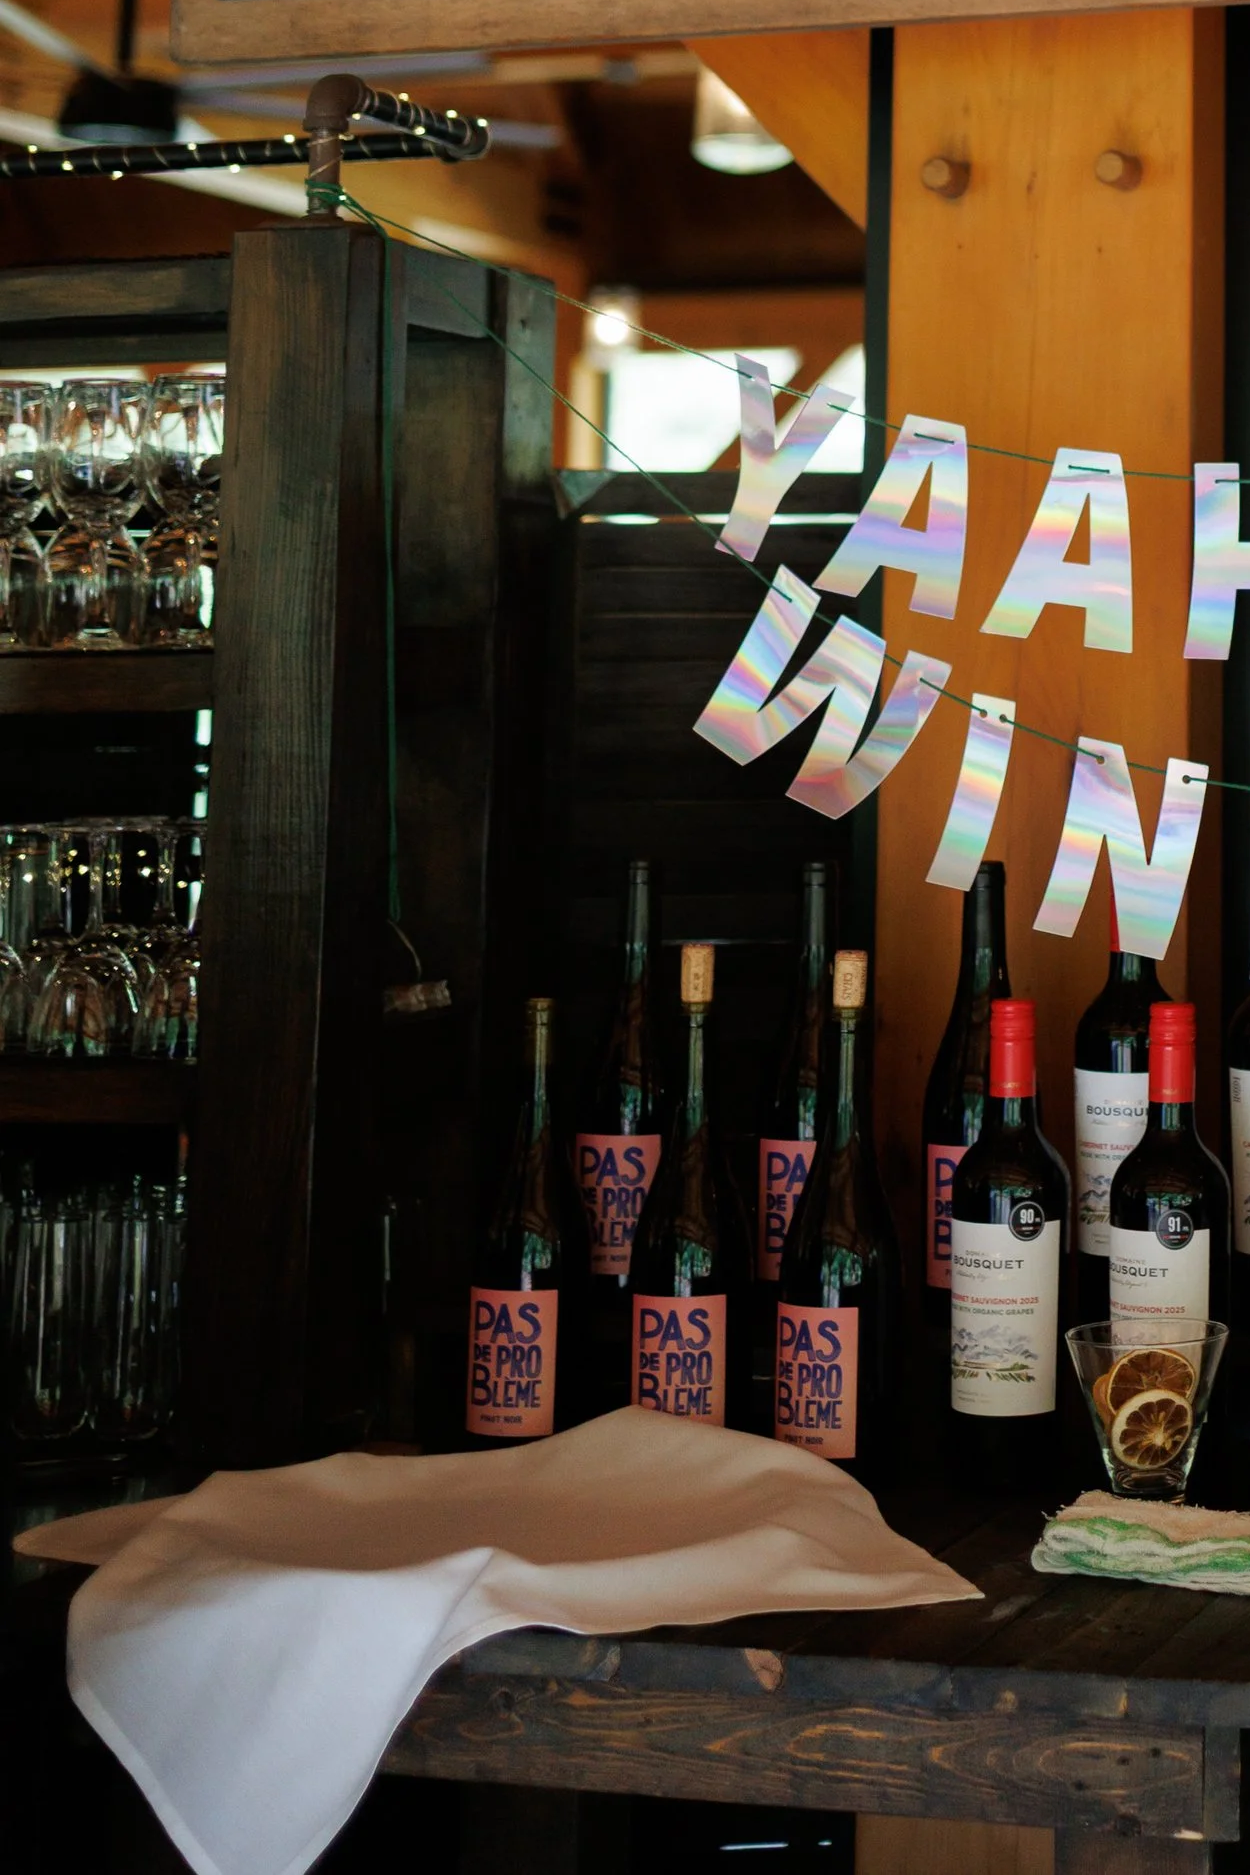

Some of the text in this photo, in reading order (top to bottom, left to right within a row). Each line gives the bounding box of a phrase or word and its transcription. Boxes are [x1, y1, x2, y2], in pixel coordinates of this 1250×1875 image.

[1086, 1105, 1149, 1117] BOUSQU
[580, 1146, 645, 1186] PAS
[767, 1152, 808, 1192] PA
[602, 1187, 646, 1219] PRO
[766, 1192, 787, 1211] DE
[1020, 1209, 1034, 1224] 90
[1168, 1216, 1180, 1232] 91
[953, 1255, 1024, 1270] BOUSQUET
[970, 1296, 1018, 1305] SAUVIGNON
[973, 1307, 1003, 1315] ORGANIC
[474, 1300, 542, 1345] PAS
[640, 1308, 712, 1351] PAS
[779, 1315, 842, 1363] PAS
[474, 1342, 542, 1379] DE PRO
[639, 1350, 713, 1386] DE PRO
[779, 1359, 843, 1399] DE PRO
